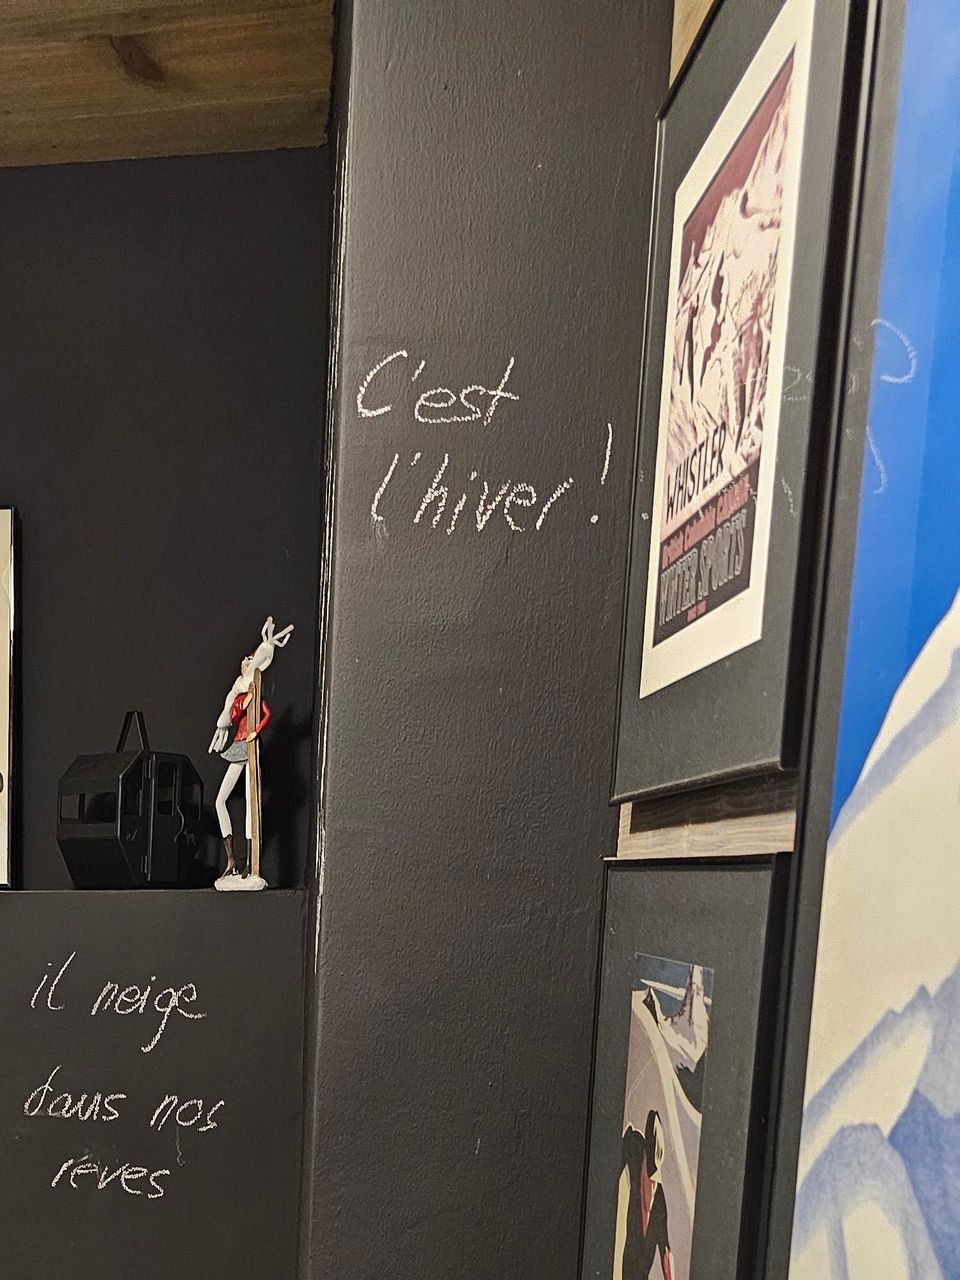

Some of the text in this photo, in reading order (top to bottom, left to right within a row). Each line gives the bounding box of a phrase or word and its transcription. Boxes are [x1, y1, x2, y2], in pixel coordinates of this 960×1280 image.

[357, 350, 520, 426] C'est
[666, 420, 727, 524] WHISTLER
[30, 951, 208, 1054] il neige
[150, 1094, 225, 1132] nos
